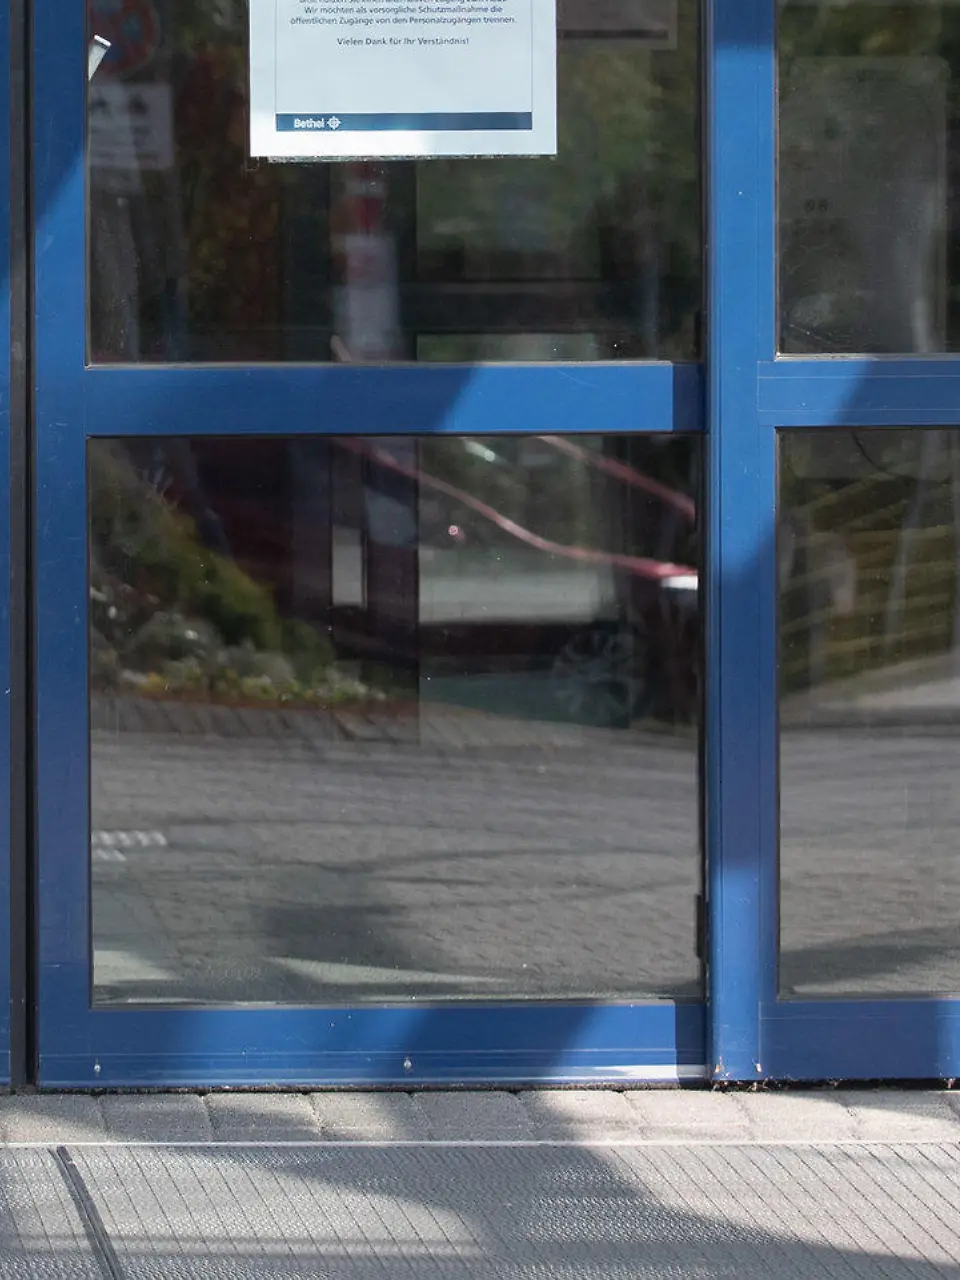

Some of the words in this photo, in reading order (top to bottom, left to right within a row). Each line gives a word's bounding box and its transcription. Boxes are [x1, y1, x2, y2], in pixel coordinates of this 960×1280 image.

[369, 6, 417, 15] vorsorgliche
[337, 37, 363, 45] Vielen
[365, 37, 388, 45] Dank
[293, 118, 325, 128] Bethel
